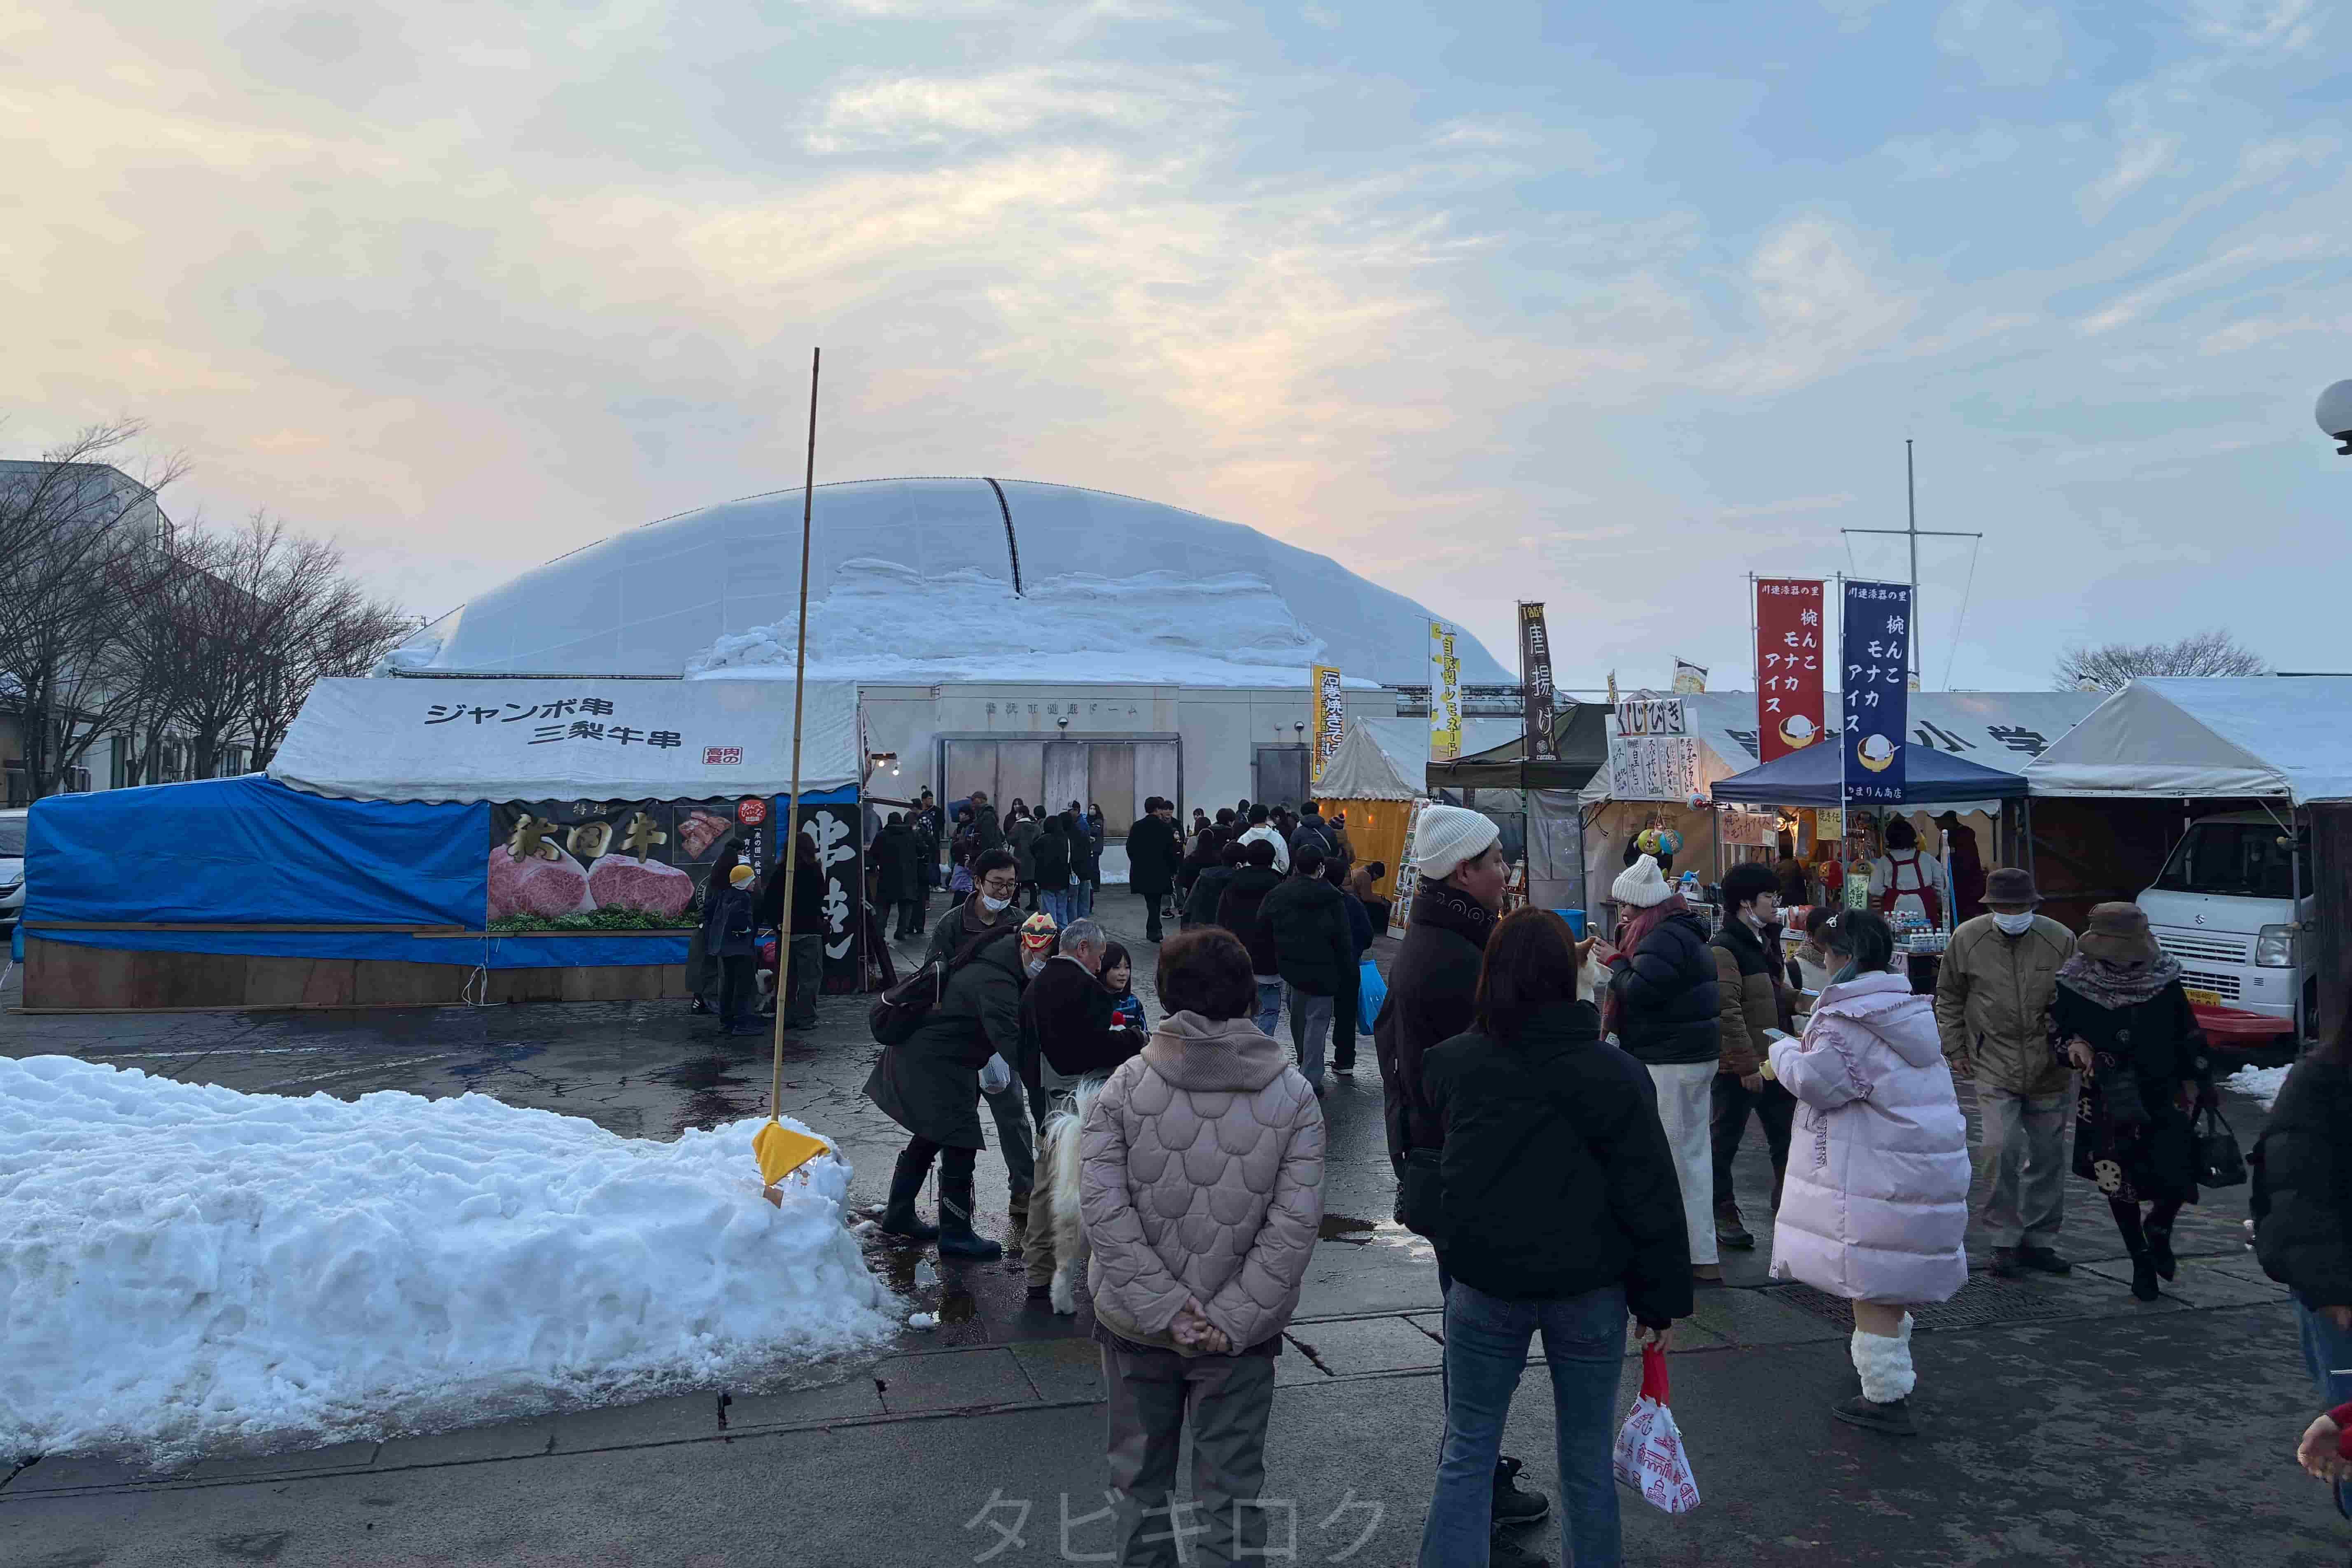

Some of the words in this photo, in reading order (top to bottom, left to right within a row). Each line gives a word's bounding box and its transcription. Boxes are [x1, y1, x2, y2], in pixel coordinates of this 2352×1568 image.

[1762, 585, 1819, 596] 川連漆器の里
[1848, 588, 1907, 601] 川連漆器の里
[1783, 632, 1799, 691] モナカ
[1800, 609, 1818, 670] 椀んこ
[1886, 616, 1905, 683] 椀んこ
[1443, 639, 1457, 757] 自家製レモネード
[1764, 653, 1781, 713] アイス
[1846, 664, 1863, 733] アイス
[1865, 641, 1883, 707] モナカ
[424, 698, 614, 725] ジャンボ串
[527, 721, 682, 749] 三梨牛串
[1617, 701, 1680, 734] くじびき
